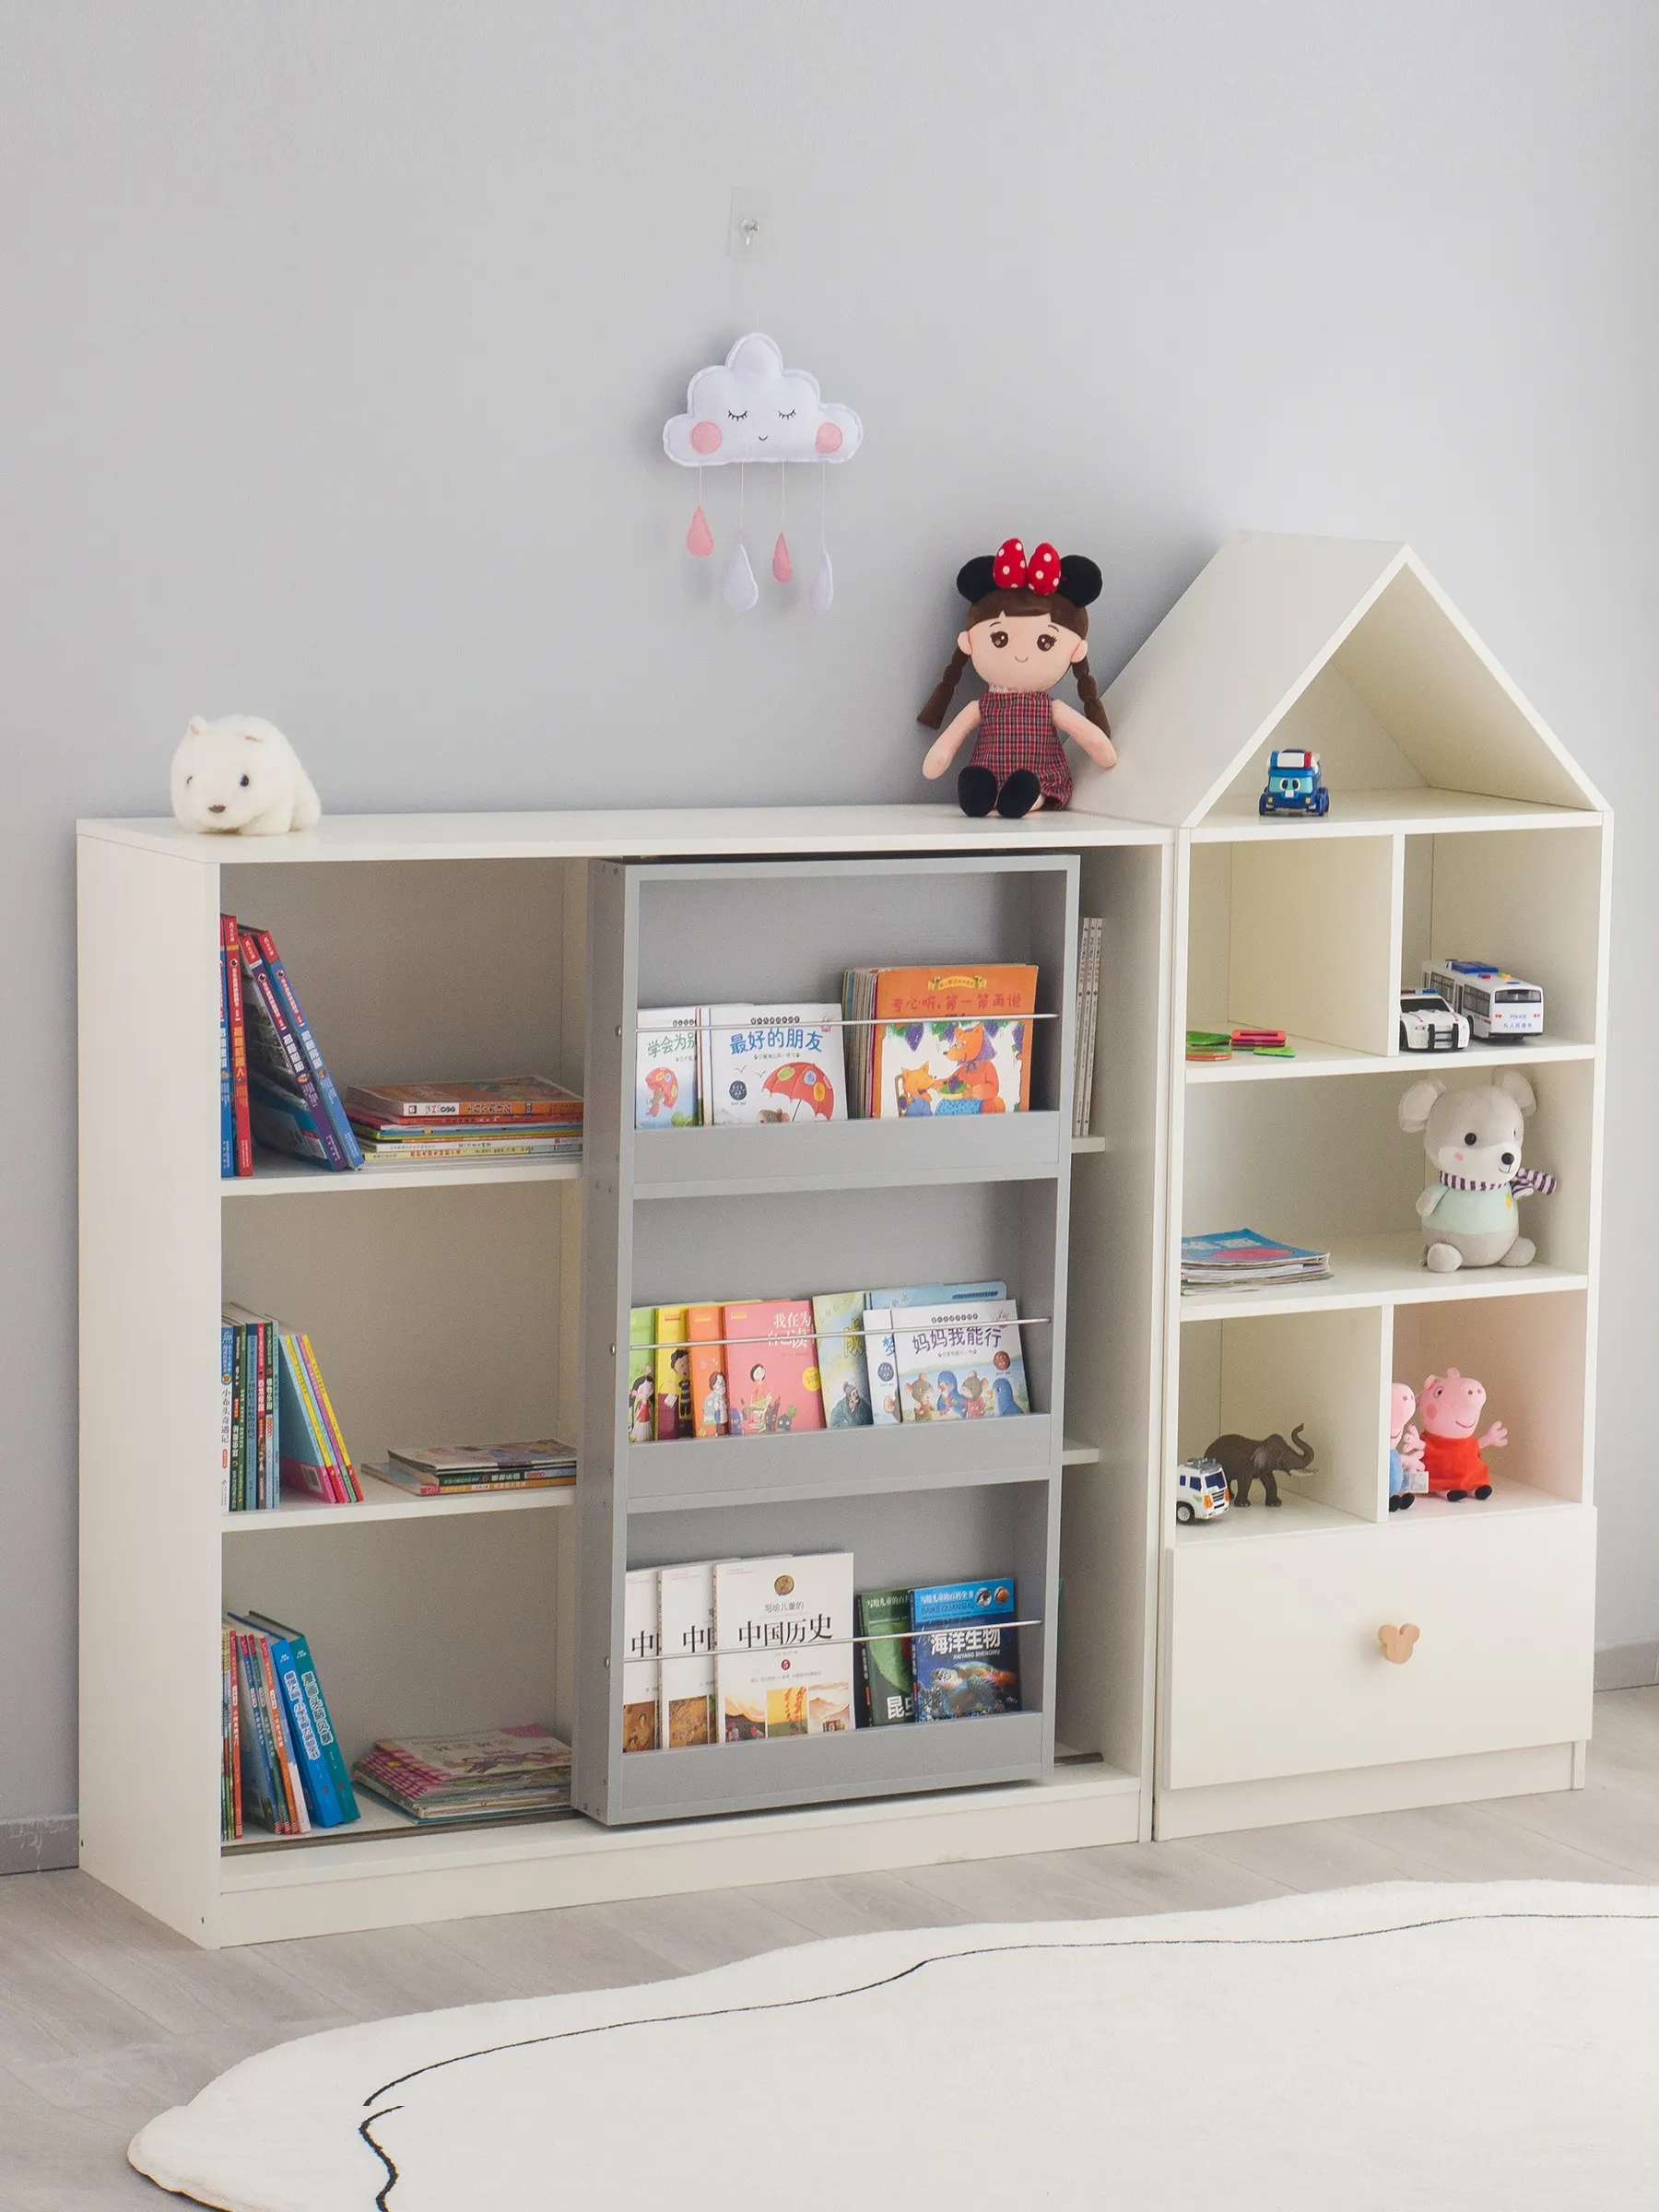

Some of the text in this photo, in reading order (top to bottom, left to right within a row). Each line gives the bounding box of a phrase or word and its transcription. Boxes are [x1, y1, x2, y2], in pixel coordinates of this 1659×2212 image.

[730, 1028, 823, 1054] 最好的朋友
[773, 1311, 811, 1329] 我在为
[912, 1326, 1002, 1355] 妈妈我能行
[765, 1600, 804, 1613] 写给儿童的
[739, 1614, 833, 1648] 中国历史
[931, 1629, 1001, 1655] 海洋生物
